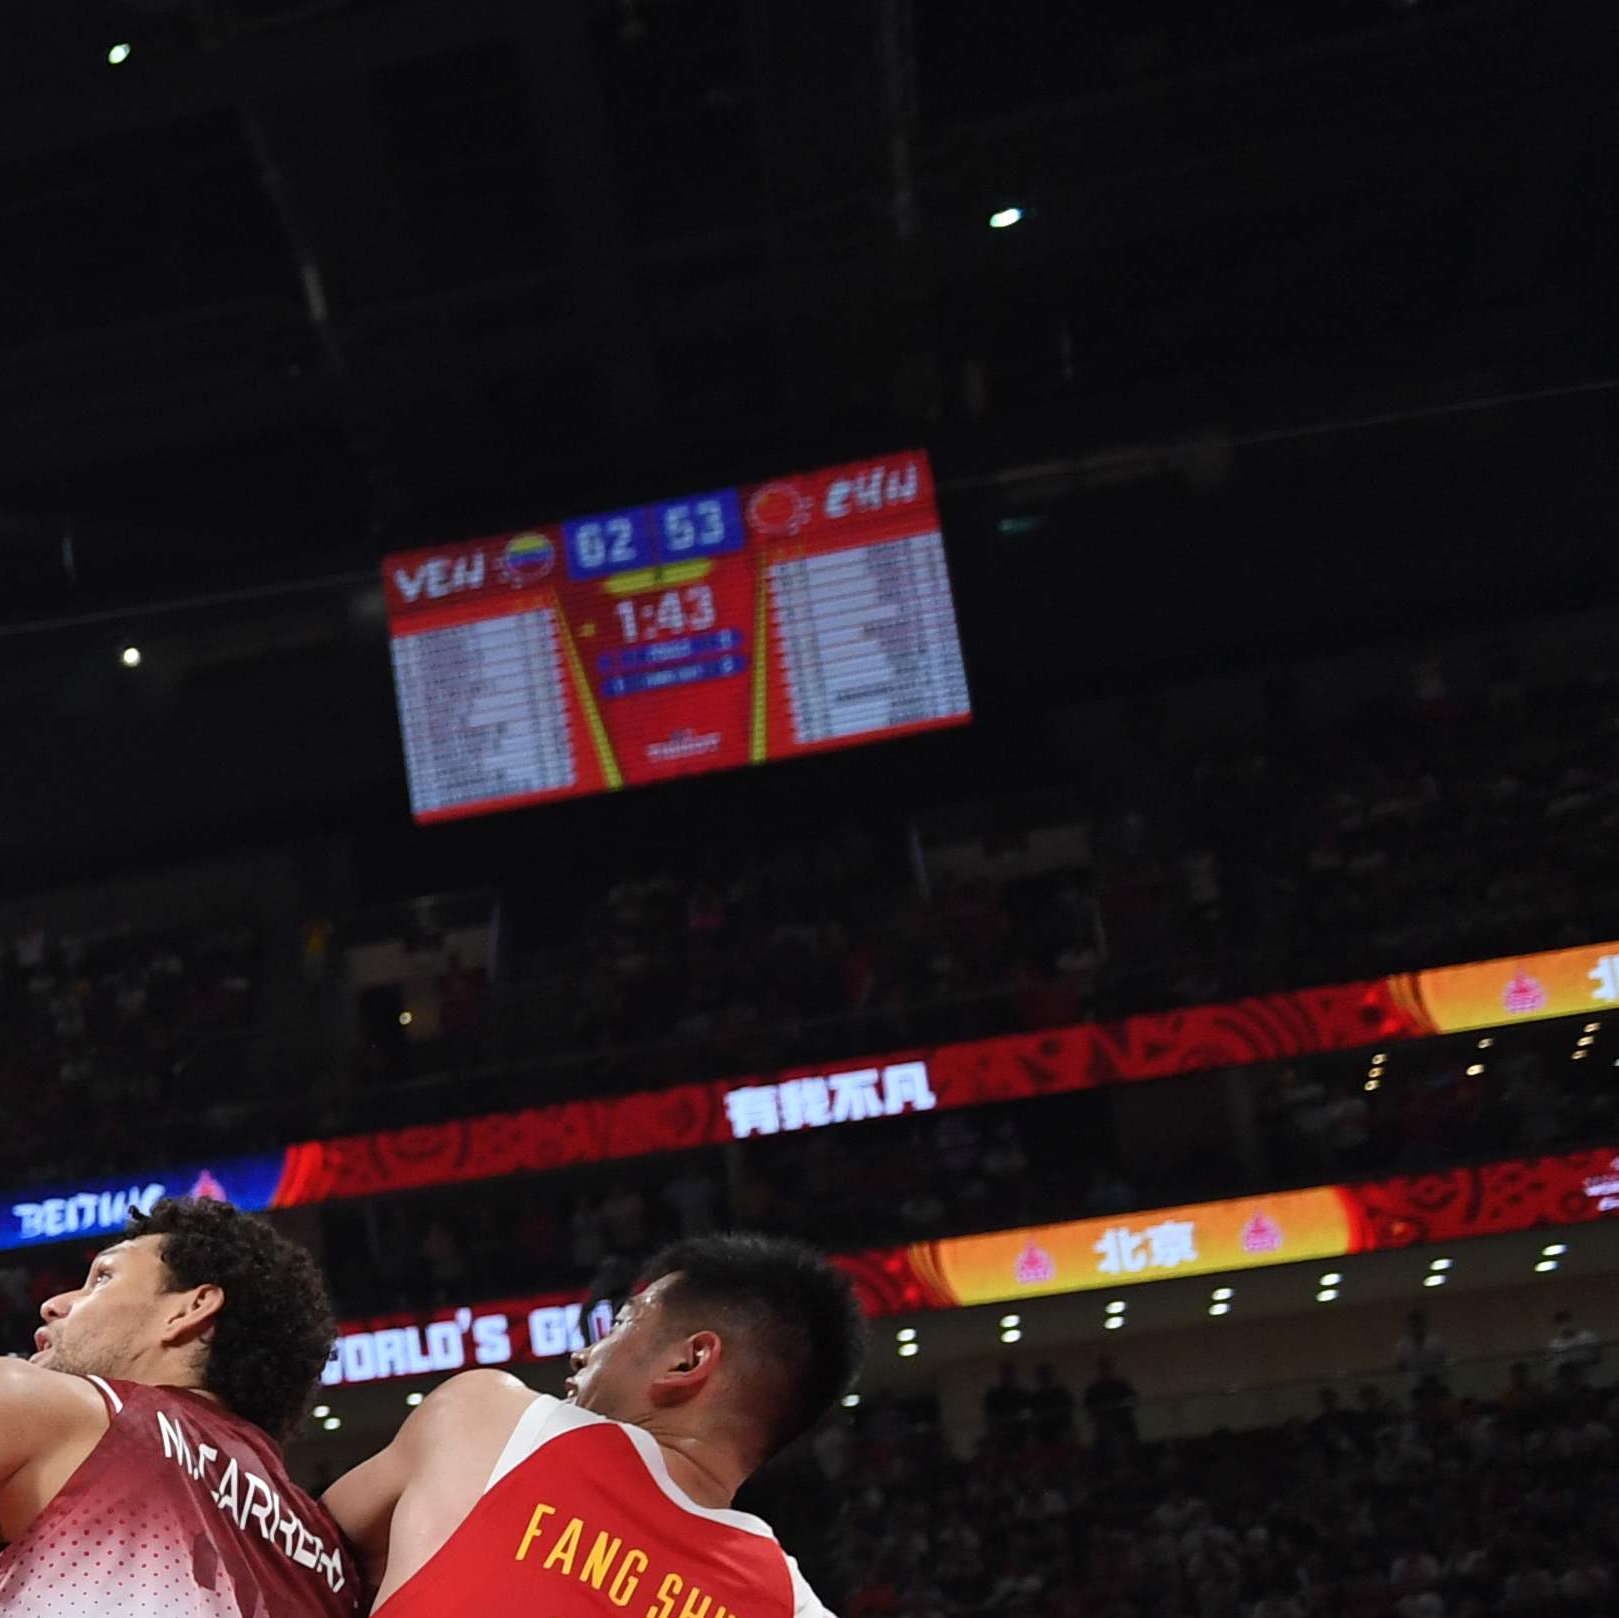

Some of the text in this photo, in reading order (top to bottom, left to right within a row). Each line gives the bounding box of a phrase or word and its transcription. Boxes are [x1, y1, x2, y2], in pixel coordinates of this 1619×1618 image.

[574, 517, 637, 569] 62
[663, 499, 725, 551] 53
[616, 585, 716, 643] 1:43
[1094, 1220, 1199, 1275] 北京
[514, 1502, 651, 1608] FANG
